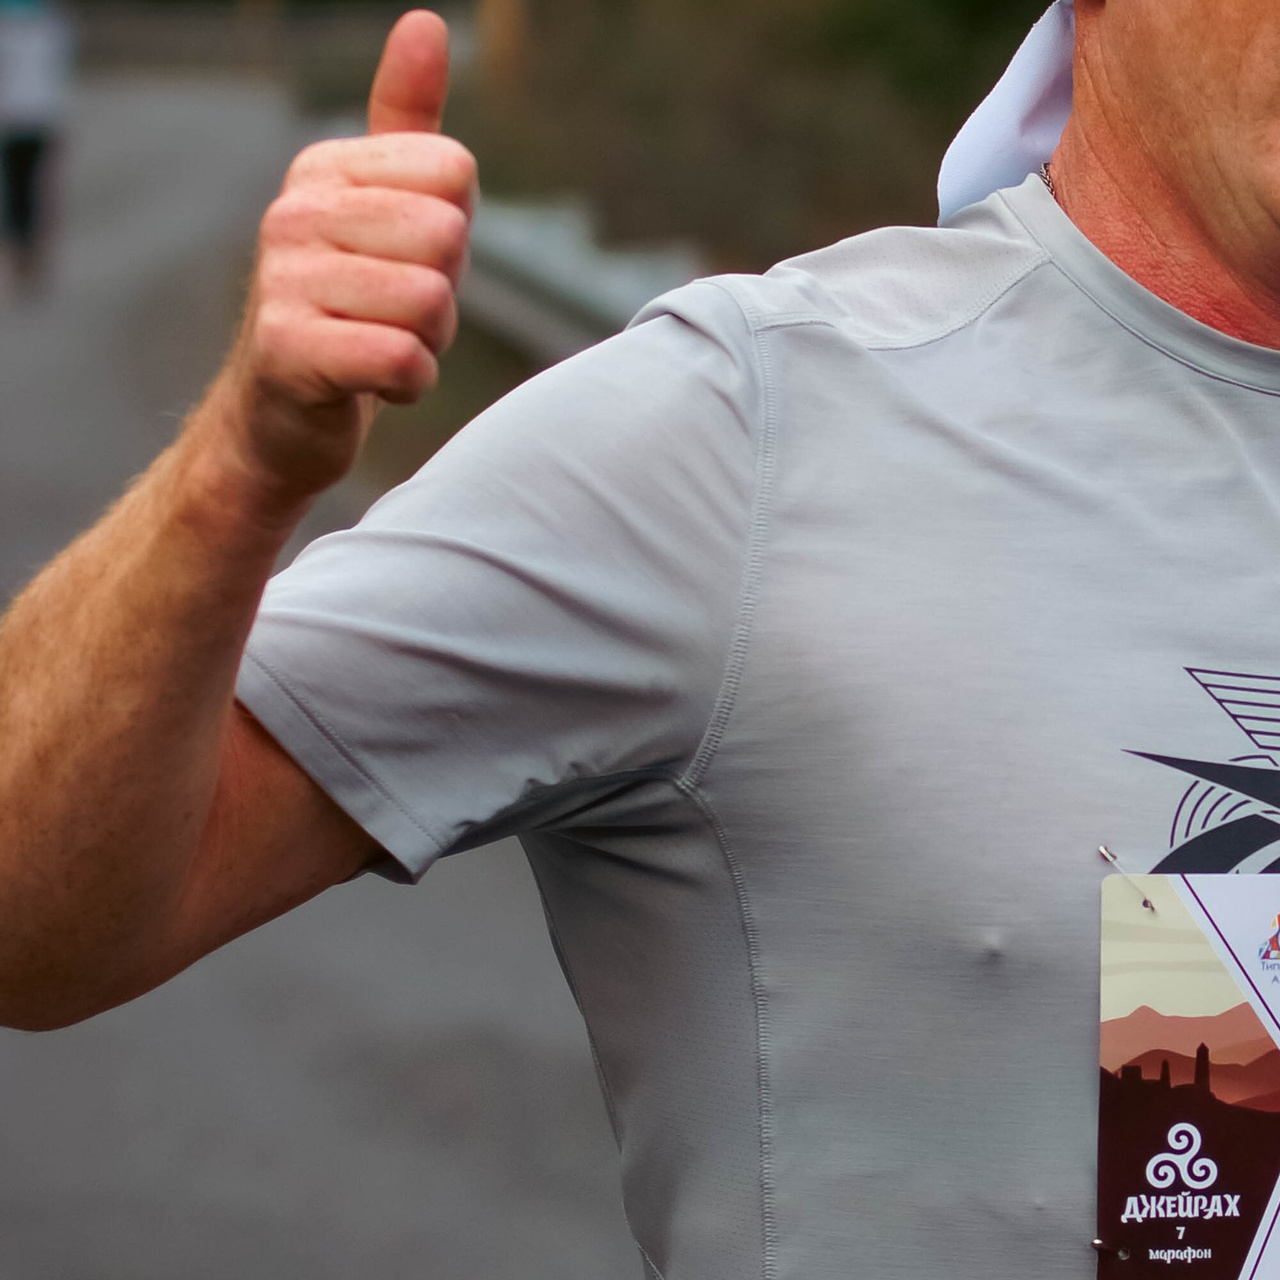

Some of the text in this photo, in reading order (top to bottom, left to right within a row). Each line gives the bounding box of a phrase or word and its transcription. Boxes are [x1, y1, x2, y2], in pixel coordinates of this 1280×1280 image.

[1121, 1190, 1241, 1223] ДЖЕЙРАХ
[1176, 1226, 1186, 1240] 7
[1148, 1246, 1212, 1264] марафон
